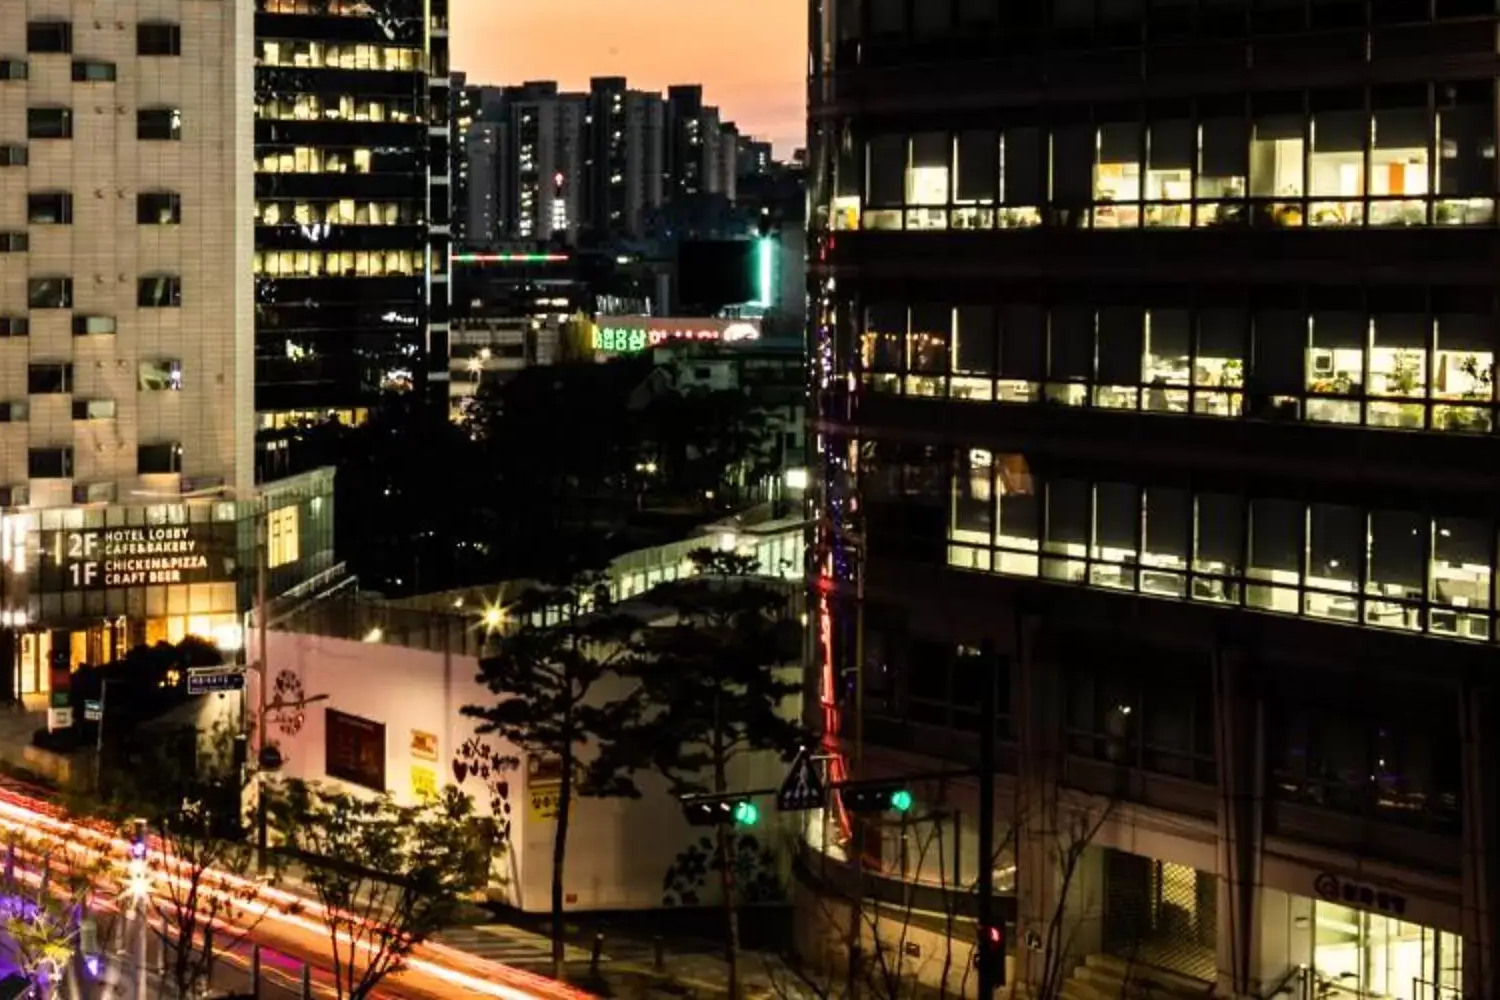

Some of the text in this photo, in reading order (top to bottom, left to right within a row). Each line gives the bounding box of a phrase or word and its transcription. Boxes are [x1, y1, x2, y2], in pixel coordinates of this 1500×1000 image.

[68, 532, 98, 557] 2F
[104, 527, 189, 543] HOTEL LOBBY
[69, 561, 98, 586] 1F
[104, 570, 181, 585] CRAFT BEER
